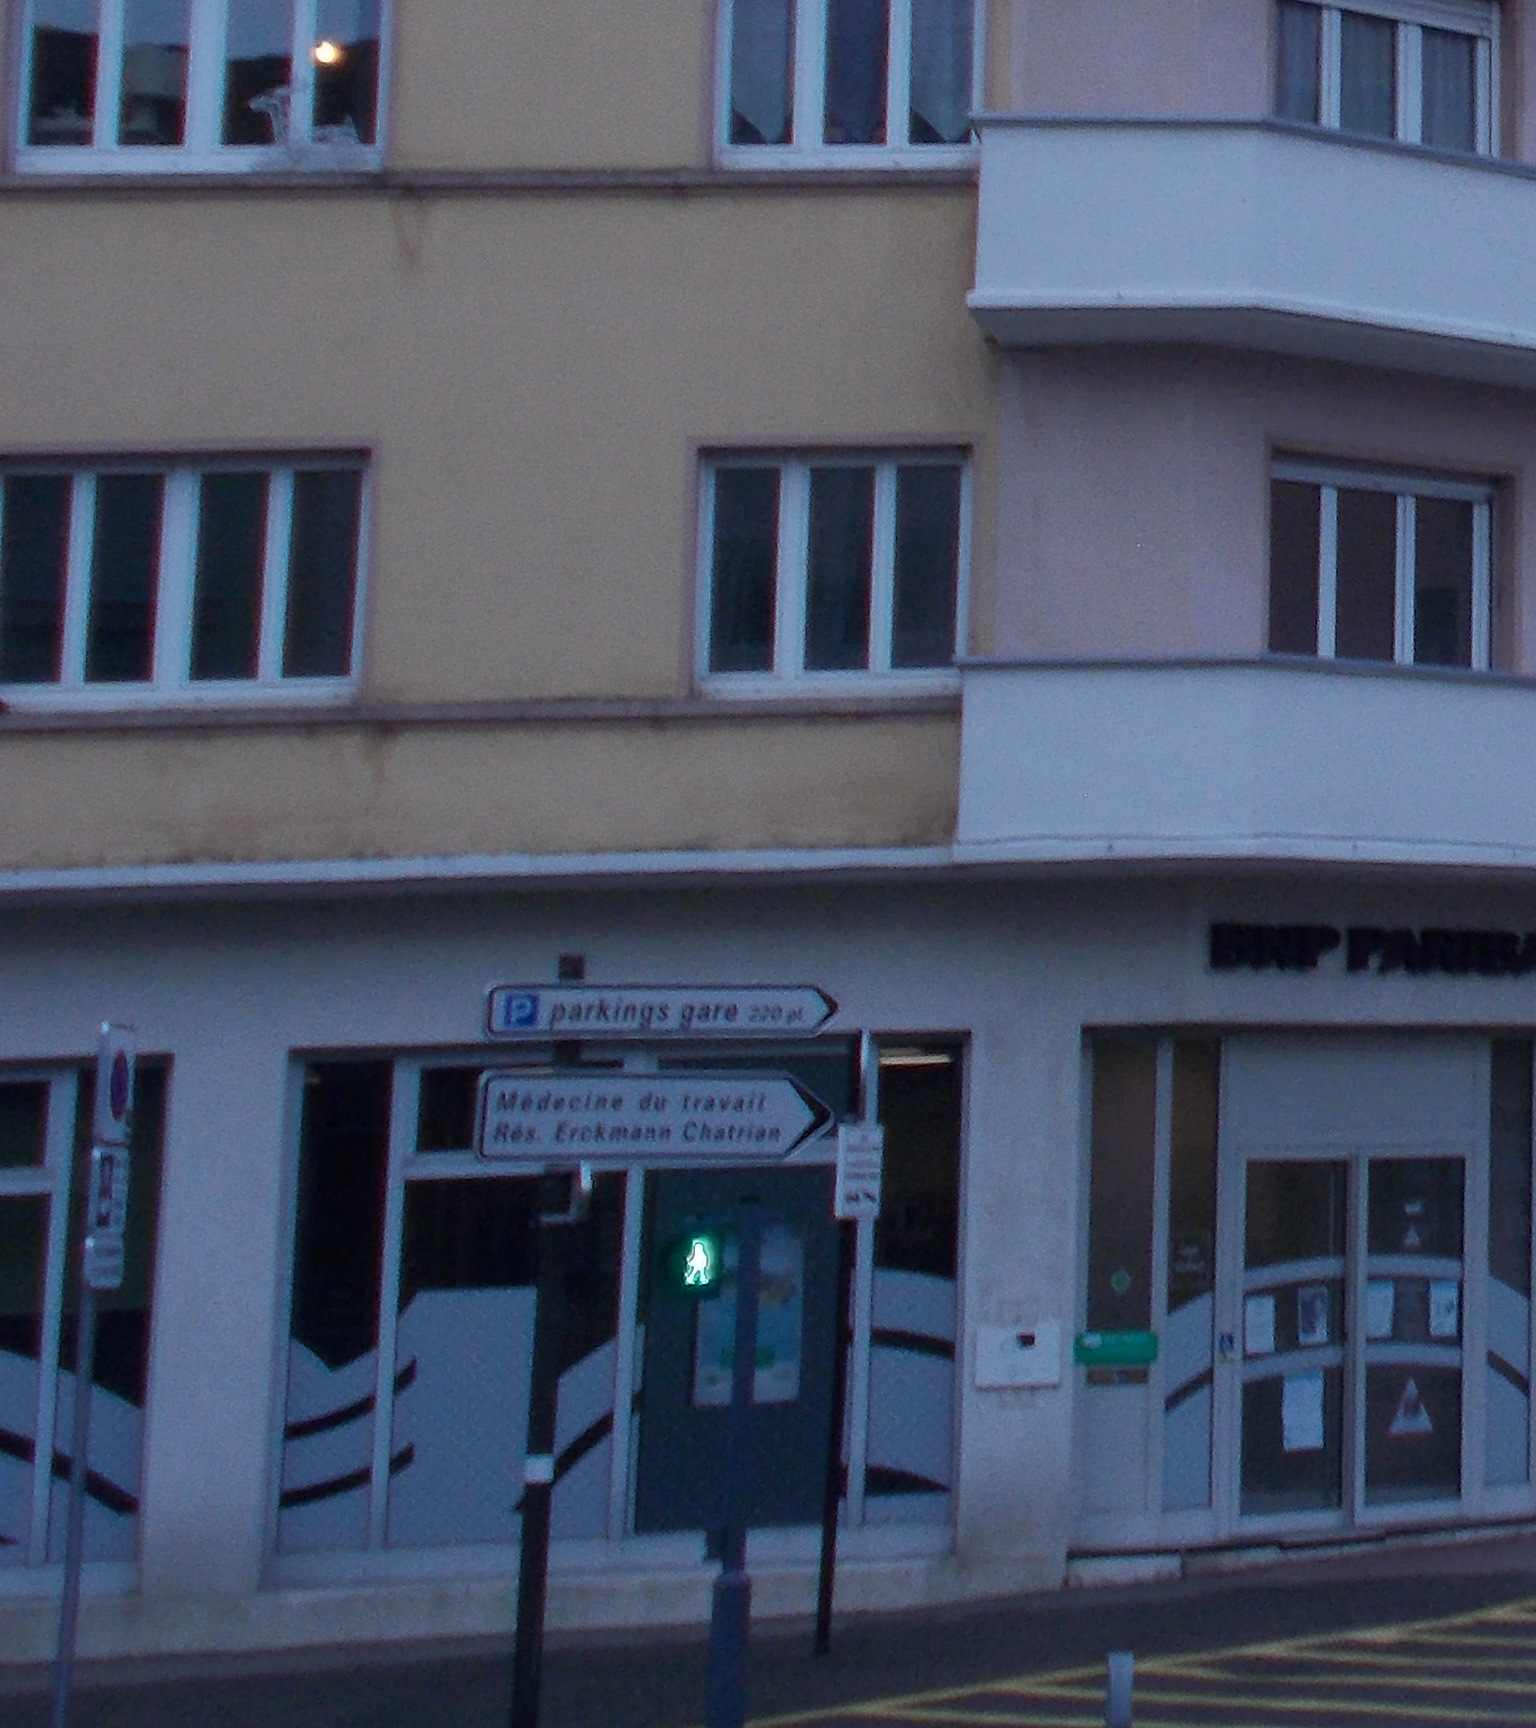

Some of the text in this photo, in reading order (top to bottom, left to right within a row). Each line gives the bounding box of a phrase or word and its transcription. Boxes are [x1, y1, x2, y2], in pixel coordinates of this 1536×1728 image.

[1210, 923, 1341, 971] BNP
[550, 998, 669, 1032] parkings
[680, 1002, 740, 1030] gare
[639, 1088, 668, 1113] du
[682, 1089, 767, 1113] travail
[554, 1120, 672, 1144] Erckmann
[680, 1120, 782, 1144] Chatrian
